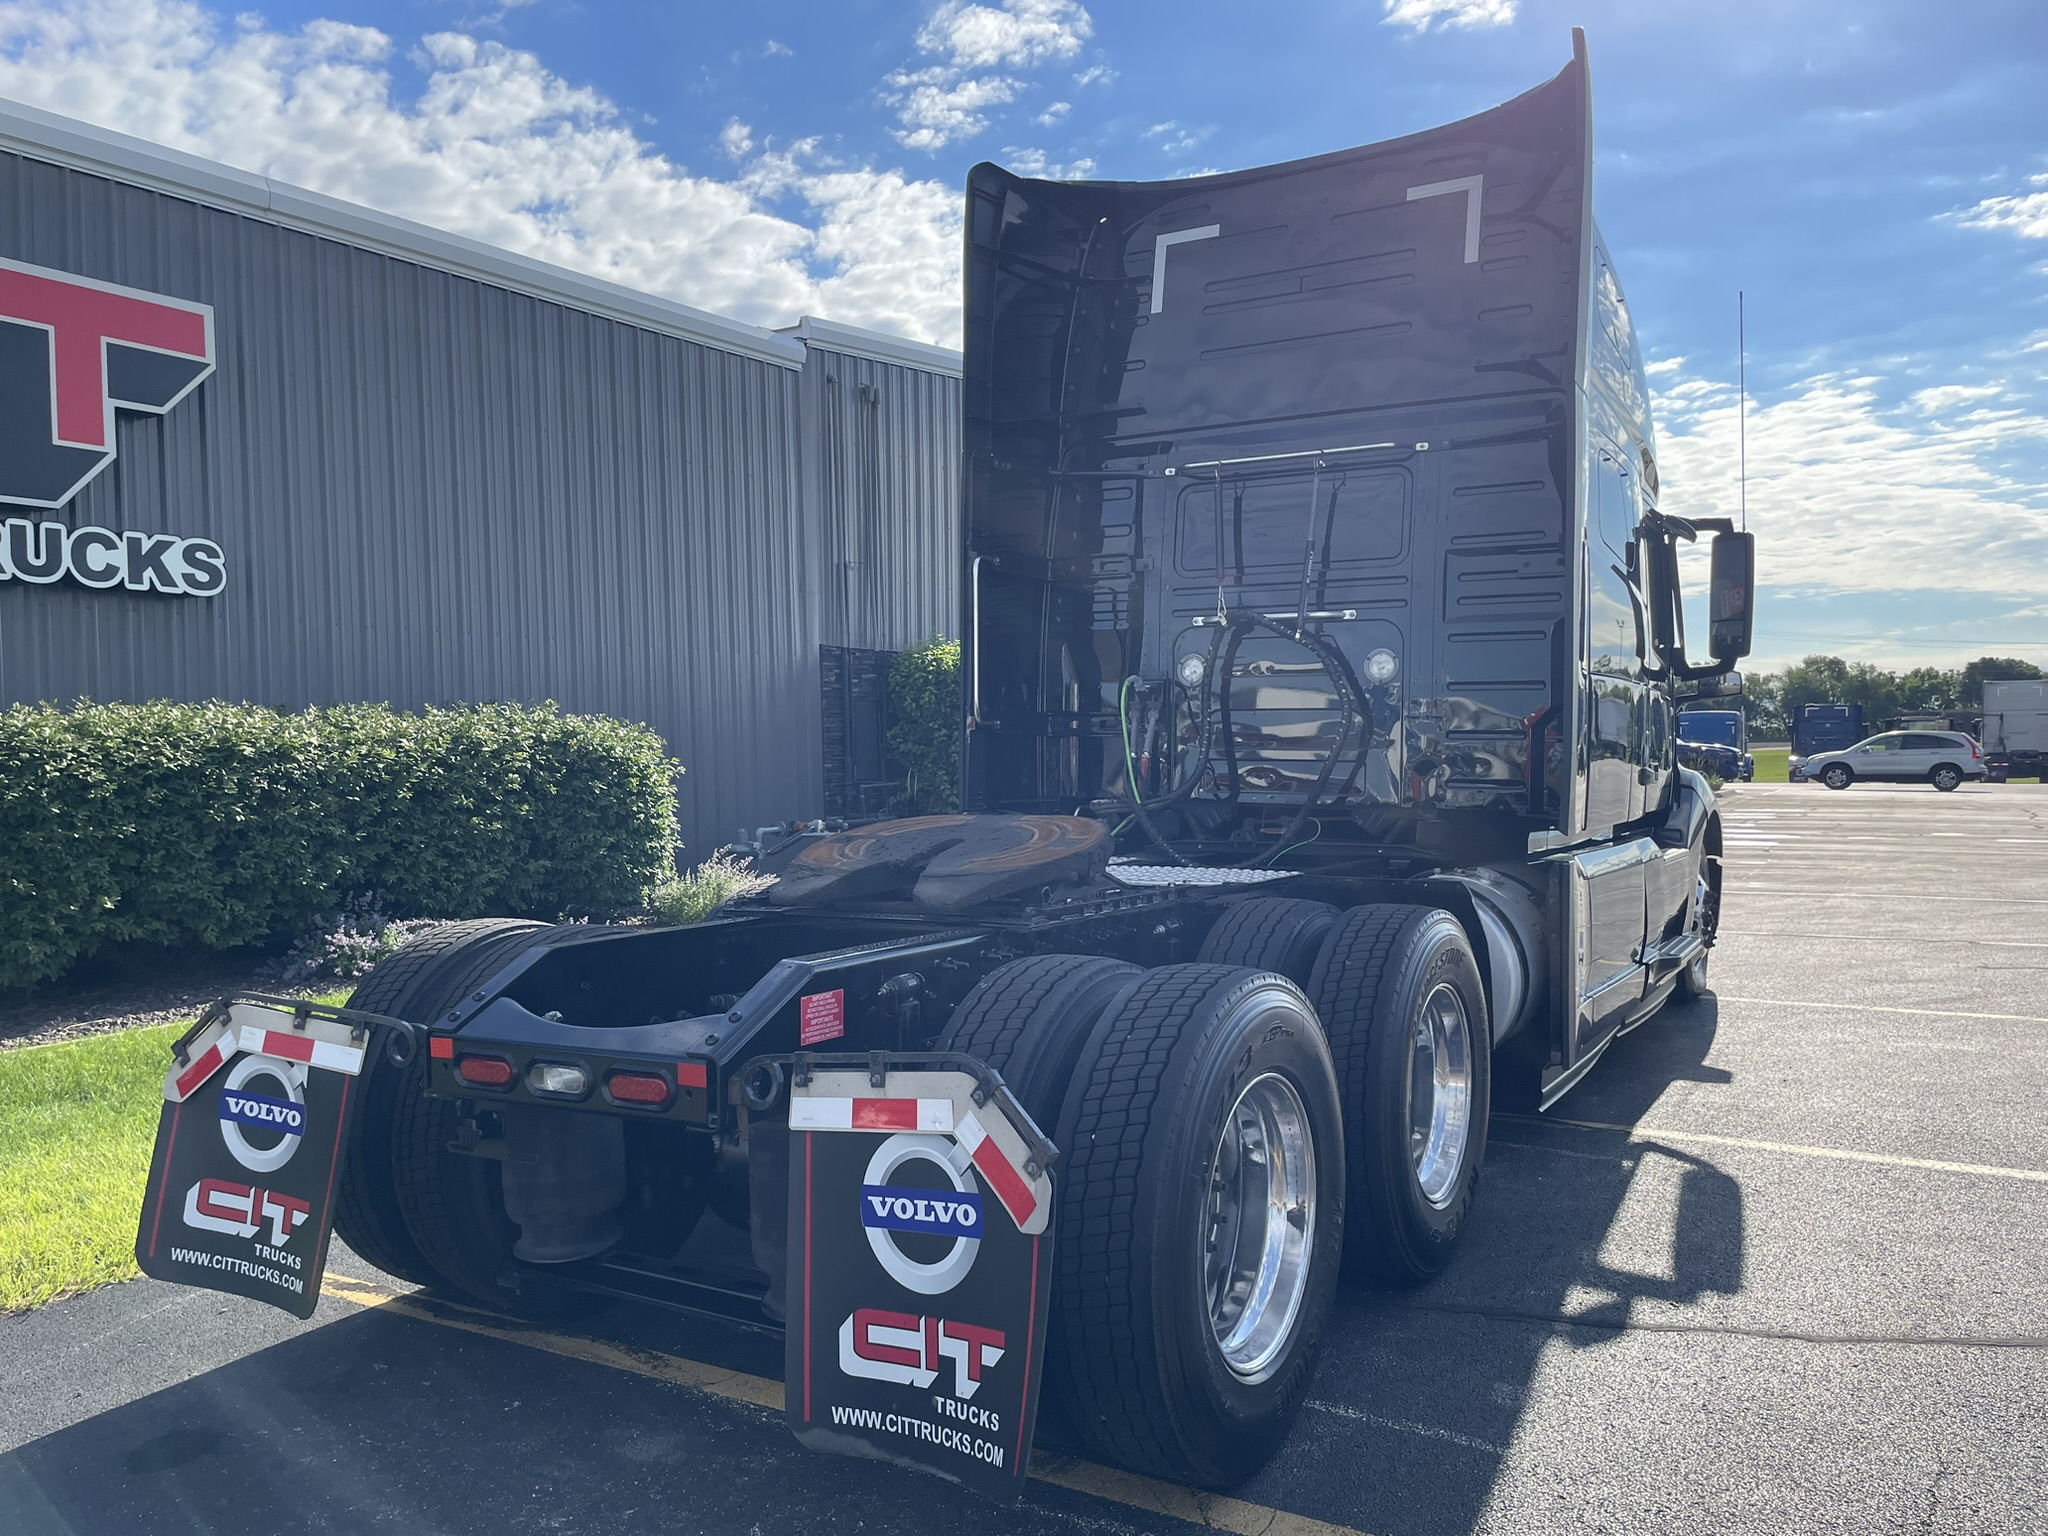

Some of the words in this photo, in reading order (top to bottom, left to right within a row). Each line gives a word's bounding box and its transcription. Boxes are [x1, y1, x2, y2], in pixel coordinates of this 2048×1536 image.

[225, 1096, 302, 1128] VOLVO
[183, 1178, 310, 1247] CIT
[867, 1195, 978, 1228] VOLVO
[171, 1246, 304, 1294] WWW.CITTRUCKS.COM
[254, 1242, 302, 1270] TRUCKS
[838, 1308, 1006, 1400] CIT
[934, 1395, 1000, 1432] TRUCKS
[831, 1405, 1004, 1469] WWW.CITTRUCKS.COM
